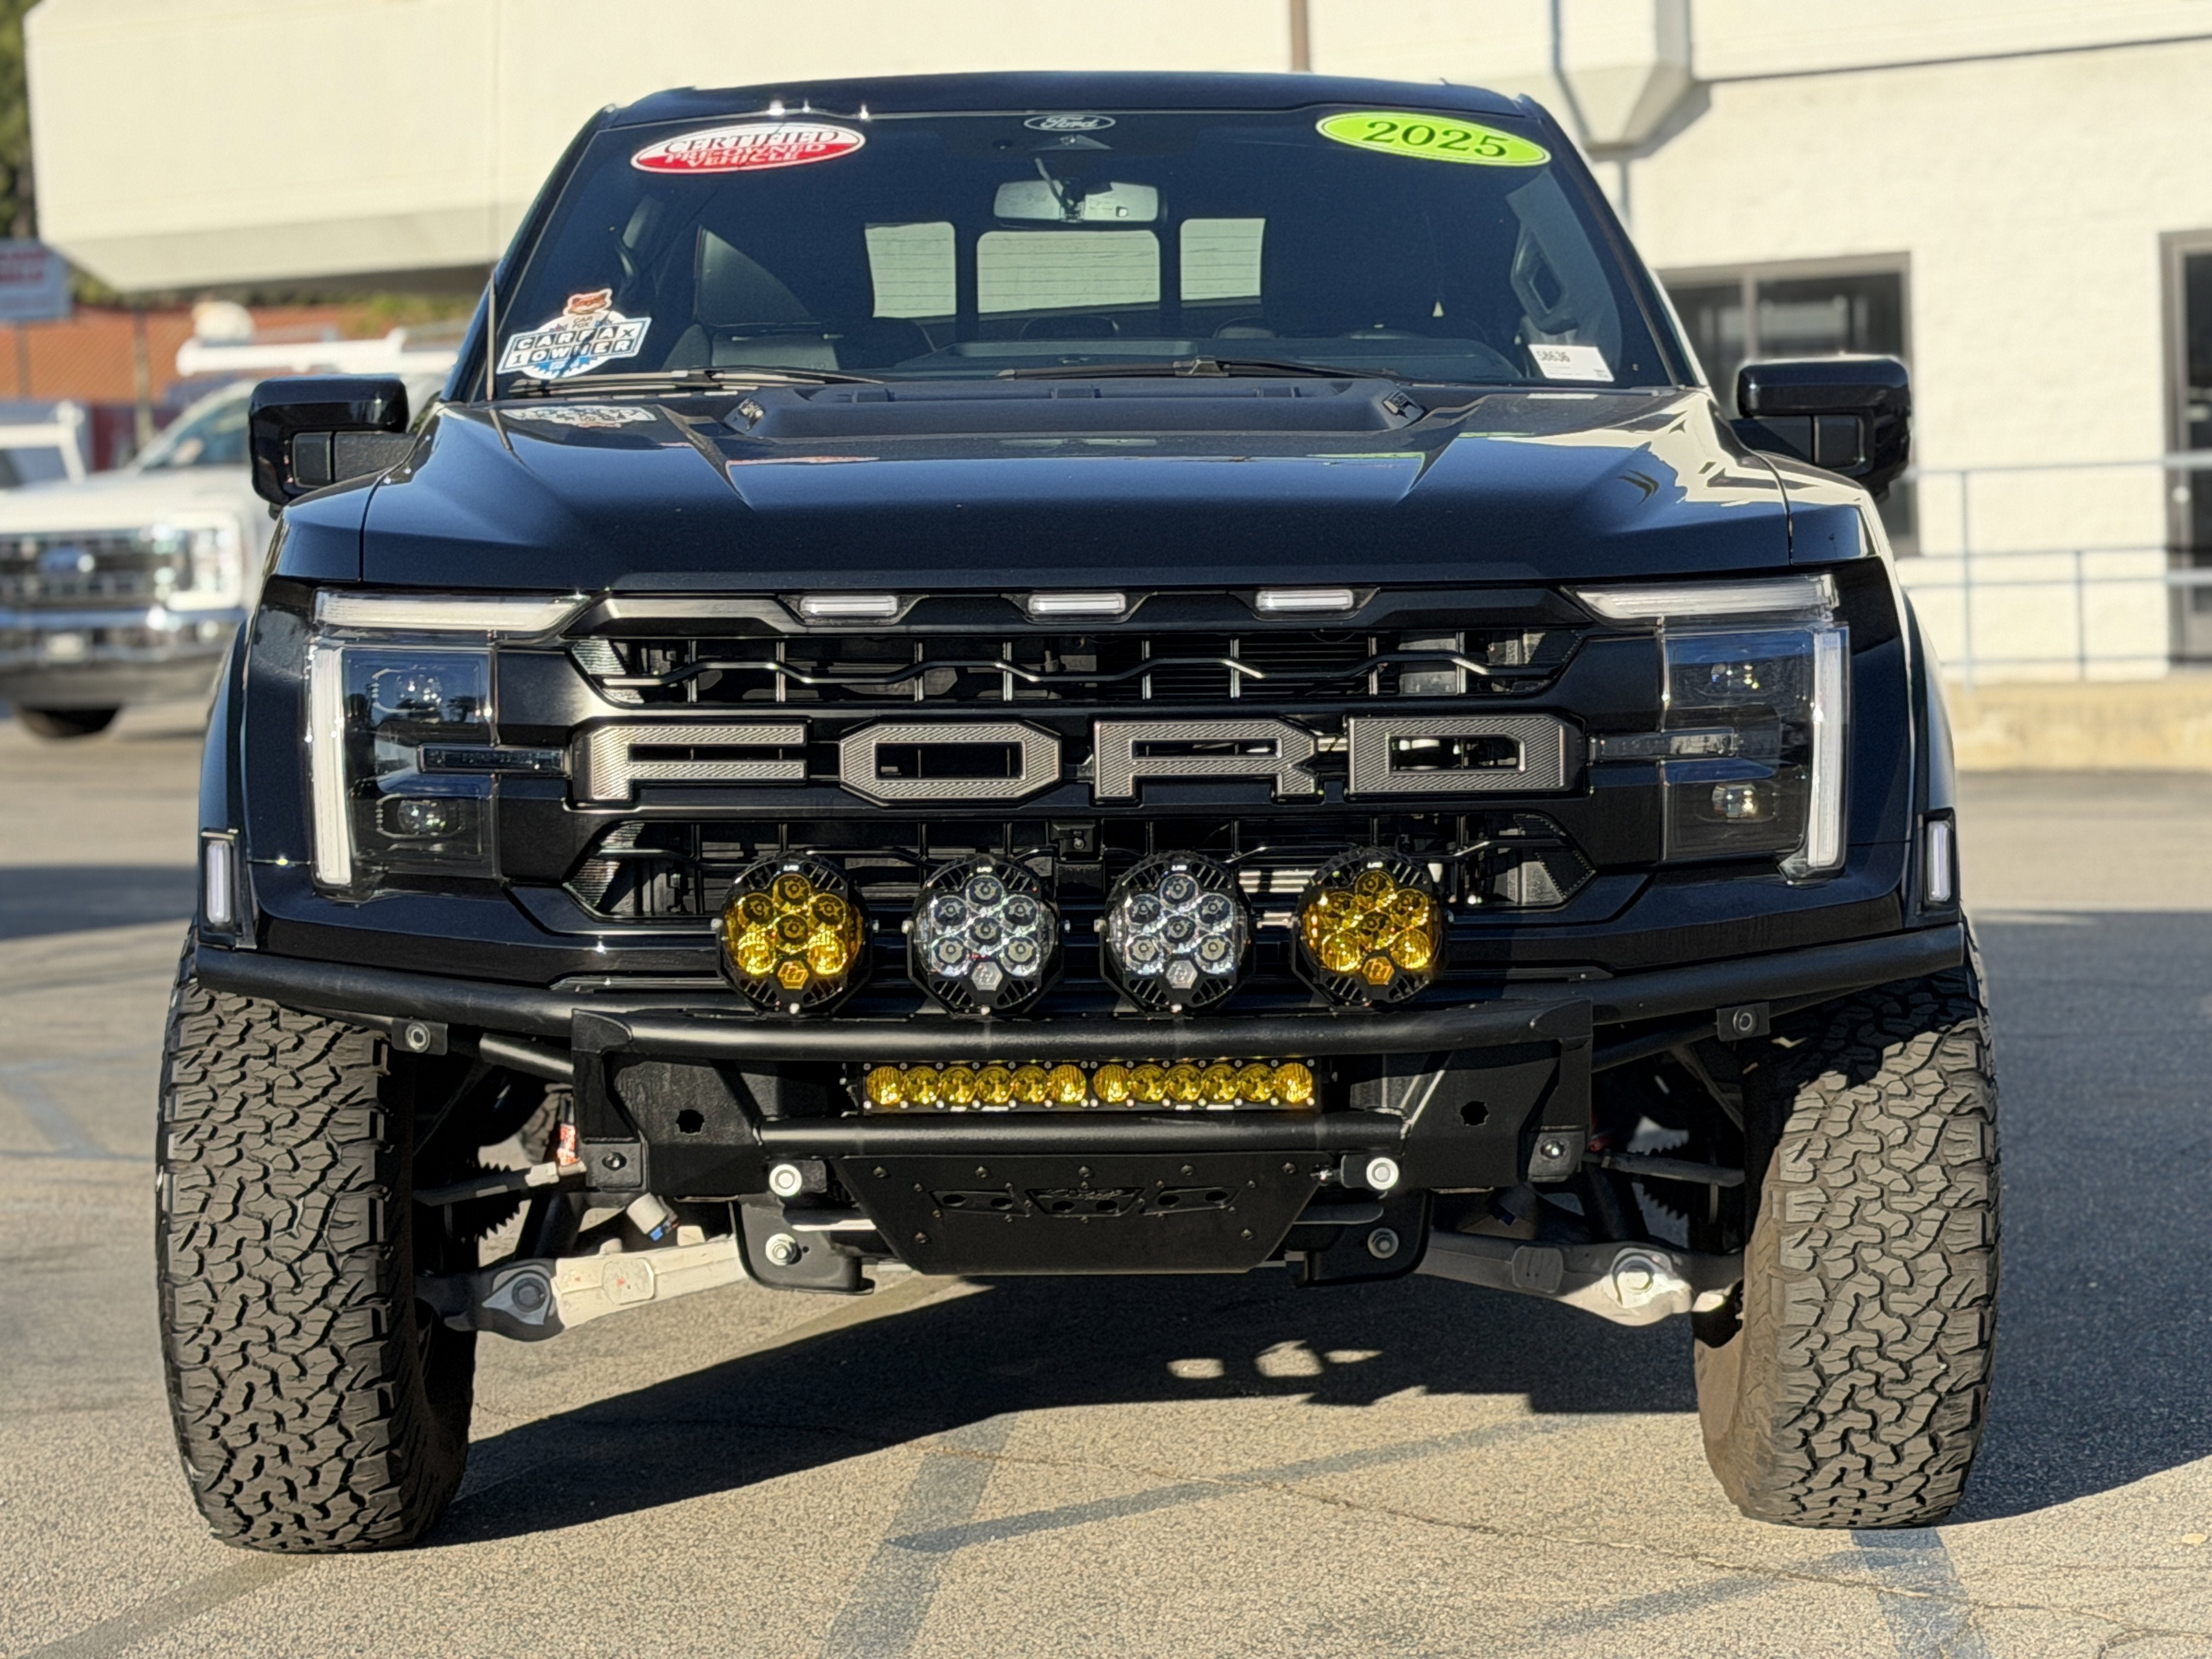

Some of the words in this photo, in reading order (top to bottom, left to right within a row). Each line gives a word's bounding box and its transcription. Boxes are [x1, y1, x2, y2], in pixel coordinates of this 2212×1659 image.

[1040, 116, 1099, 129] Ford
[664, 131, 839, 154] CERTIFIED
[1362, 121, 1509, 157] 2025
[687, 152, 799, 167] VEHICLE
[573, 315, 593, 324] CAR
[517, 326, 634, 349] CARFAX
[590, 716, 1565, 802] FORD
